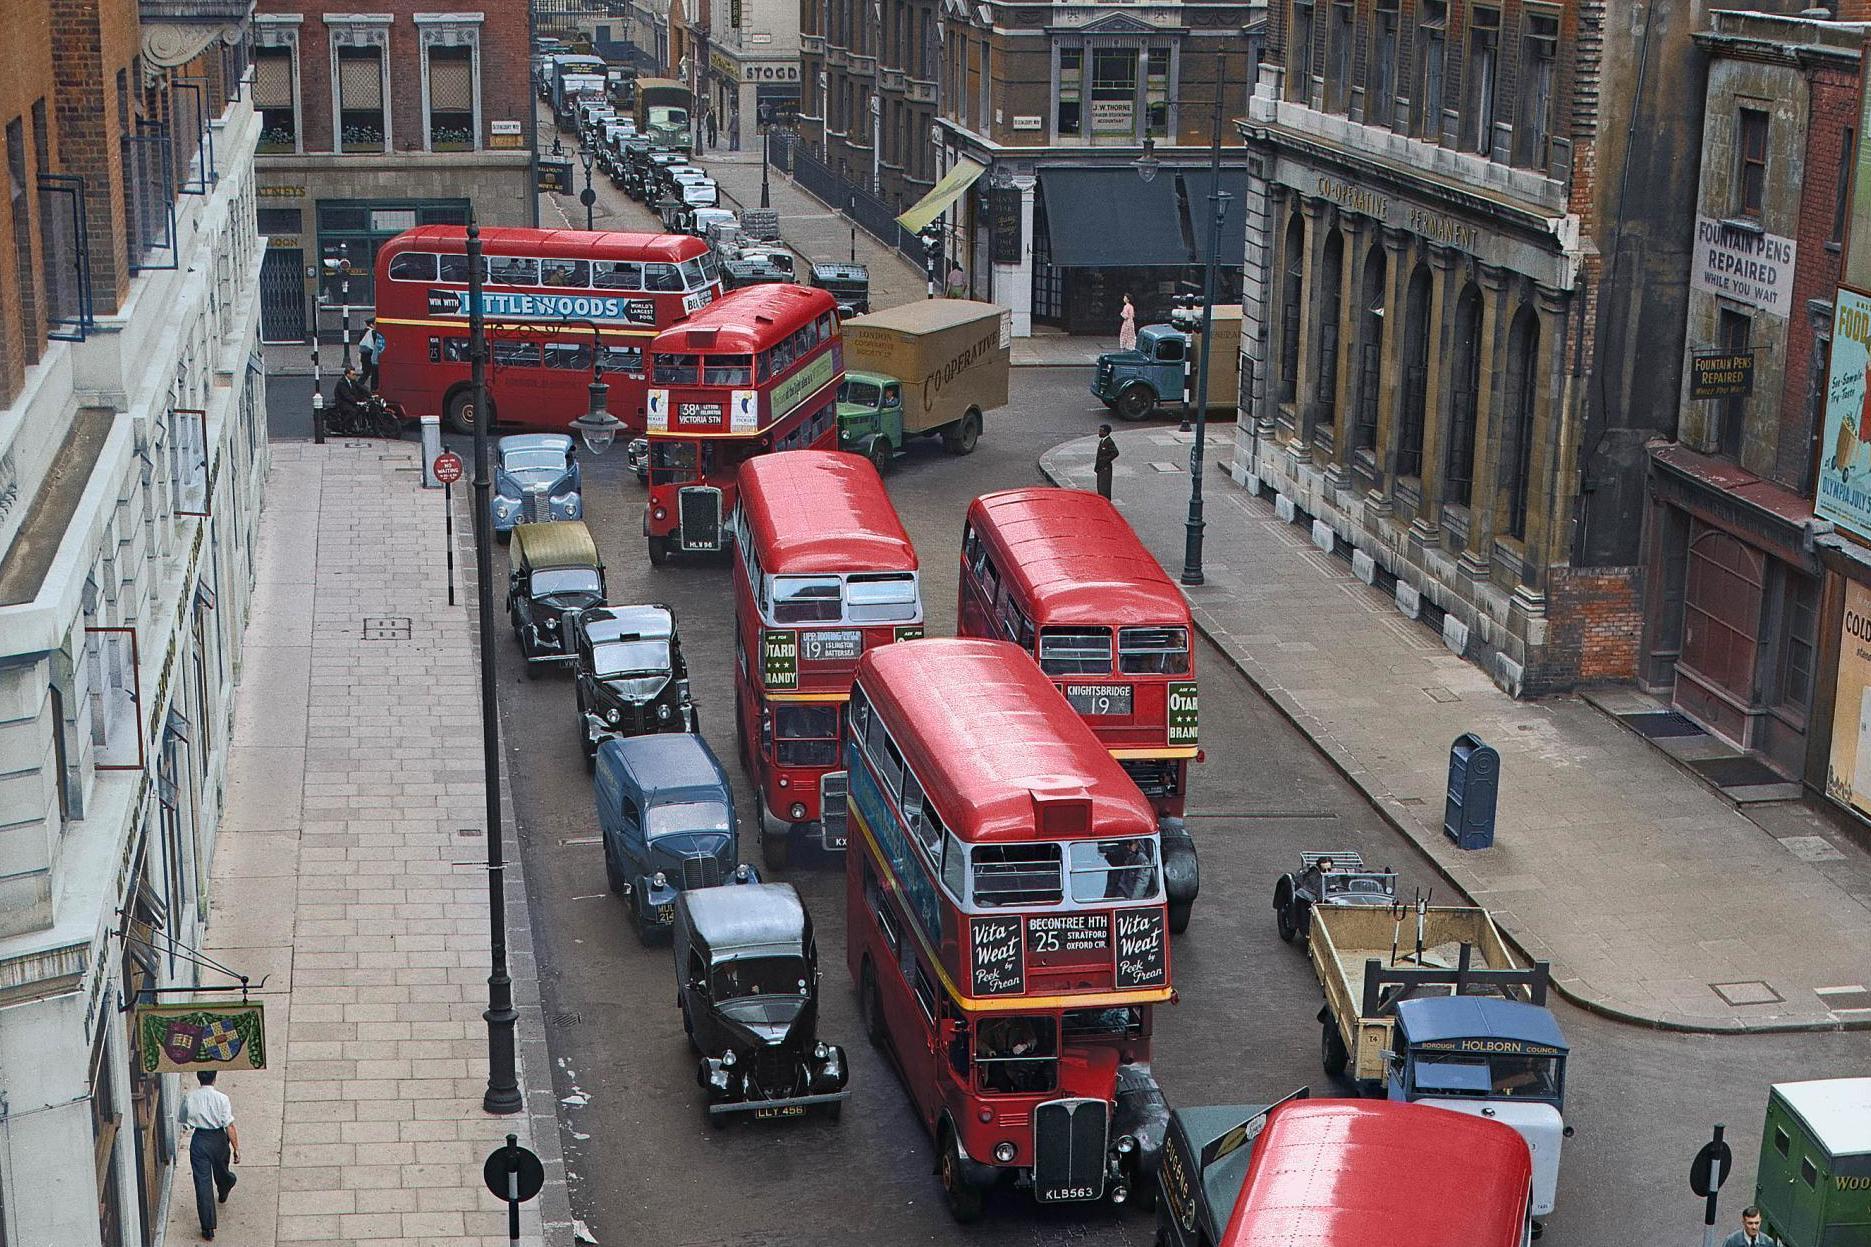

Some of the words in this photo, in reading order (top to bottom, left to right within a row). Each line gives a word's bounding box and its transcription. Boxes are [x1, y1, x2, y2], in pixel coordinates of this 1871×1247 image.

[746, 66, 800, 80] STOGD
[1409, 208, 1478, 251] PERMANENT
[1699, 221, 1755, 254] FOUNTAIN
[1756, 236, 1791, 265] PENS
[1708, 249, 1777, 285] REPAIRED
[1704, 271, 1729, 289] WHILE
[1733, 280, 1751, 296] YOU
[1755, 286, 1778, 304] WAIT
[443, 298, 459, 307] WITH
[464, 294, 619, 317] LTTLEWOODS
[1839, 304, 1869, 344] FOOD
[859, 331, 892, 340] LONDON
[1696, 358, 1732, 370] FOUNTAIN
[1733, 356, 1752, 369] PENS
[1702, 371, 1744, 384] REPAIRED
[679, 415, 707, 425] VICTORIA
[708, 415, 721, 424] STN
[1822, 476, 1850, 504] OLYMPIA
[1850, 489, 1867, 511] JULY
[806, 642, 822, 658] 19
[1068, 685, 1131, 697] KNIGHTSBRIDGE
[1092, 697, 1110, 715] 19
[1030, 917, 1085, 930] BECONTREE
[1088, 915, 1107, 928] HTH
[1035, 931, 1060, 952] 25
[1067, 930, 1107, 939] STRATFORD
[1066, 941, 1093, 950] OXFORD
[1121, 927, 1162, 957] Weat
[976, 935, 1020, 965] Weat
[1147, 954, 1156, 962] by
[1005, 961, 1013, 971] by
[1120, 960, 1143, 975] Peek
[976, 968, 1000, 983] Peek
[1132, 967, 1162, 983] Frean
[990, 976, 1020, 992] Frean
[1422, 1042, 1455, 1050] BOROUGH
[1462, 1040, 1521, 1052] HOLBORN
[1526, 1046, 1559, 1054] COUNCIL
[758, 1107, 779, 1117] LLY
[1836, 1176, 1871, 1190] WOO
[1046, 1187, 1093, 1200] KLB563
